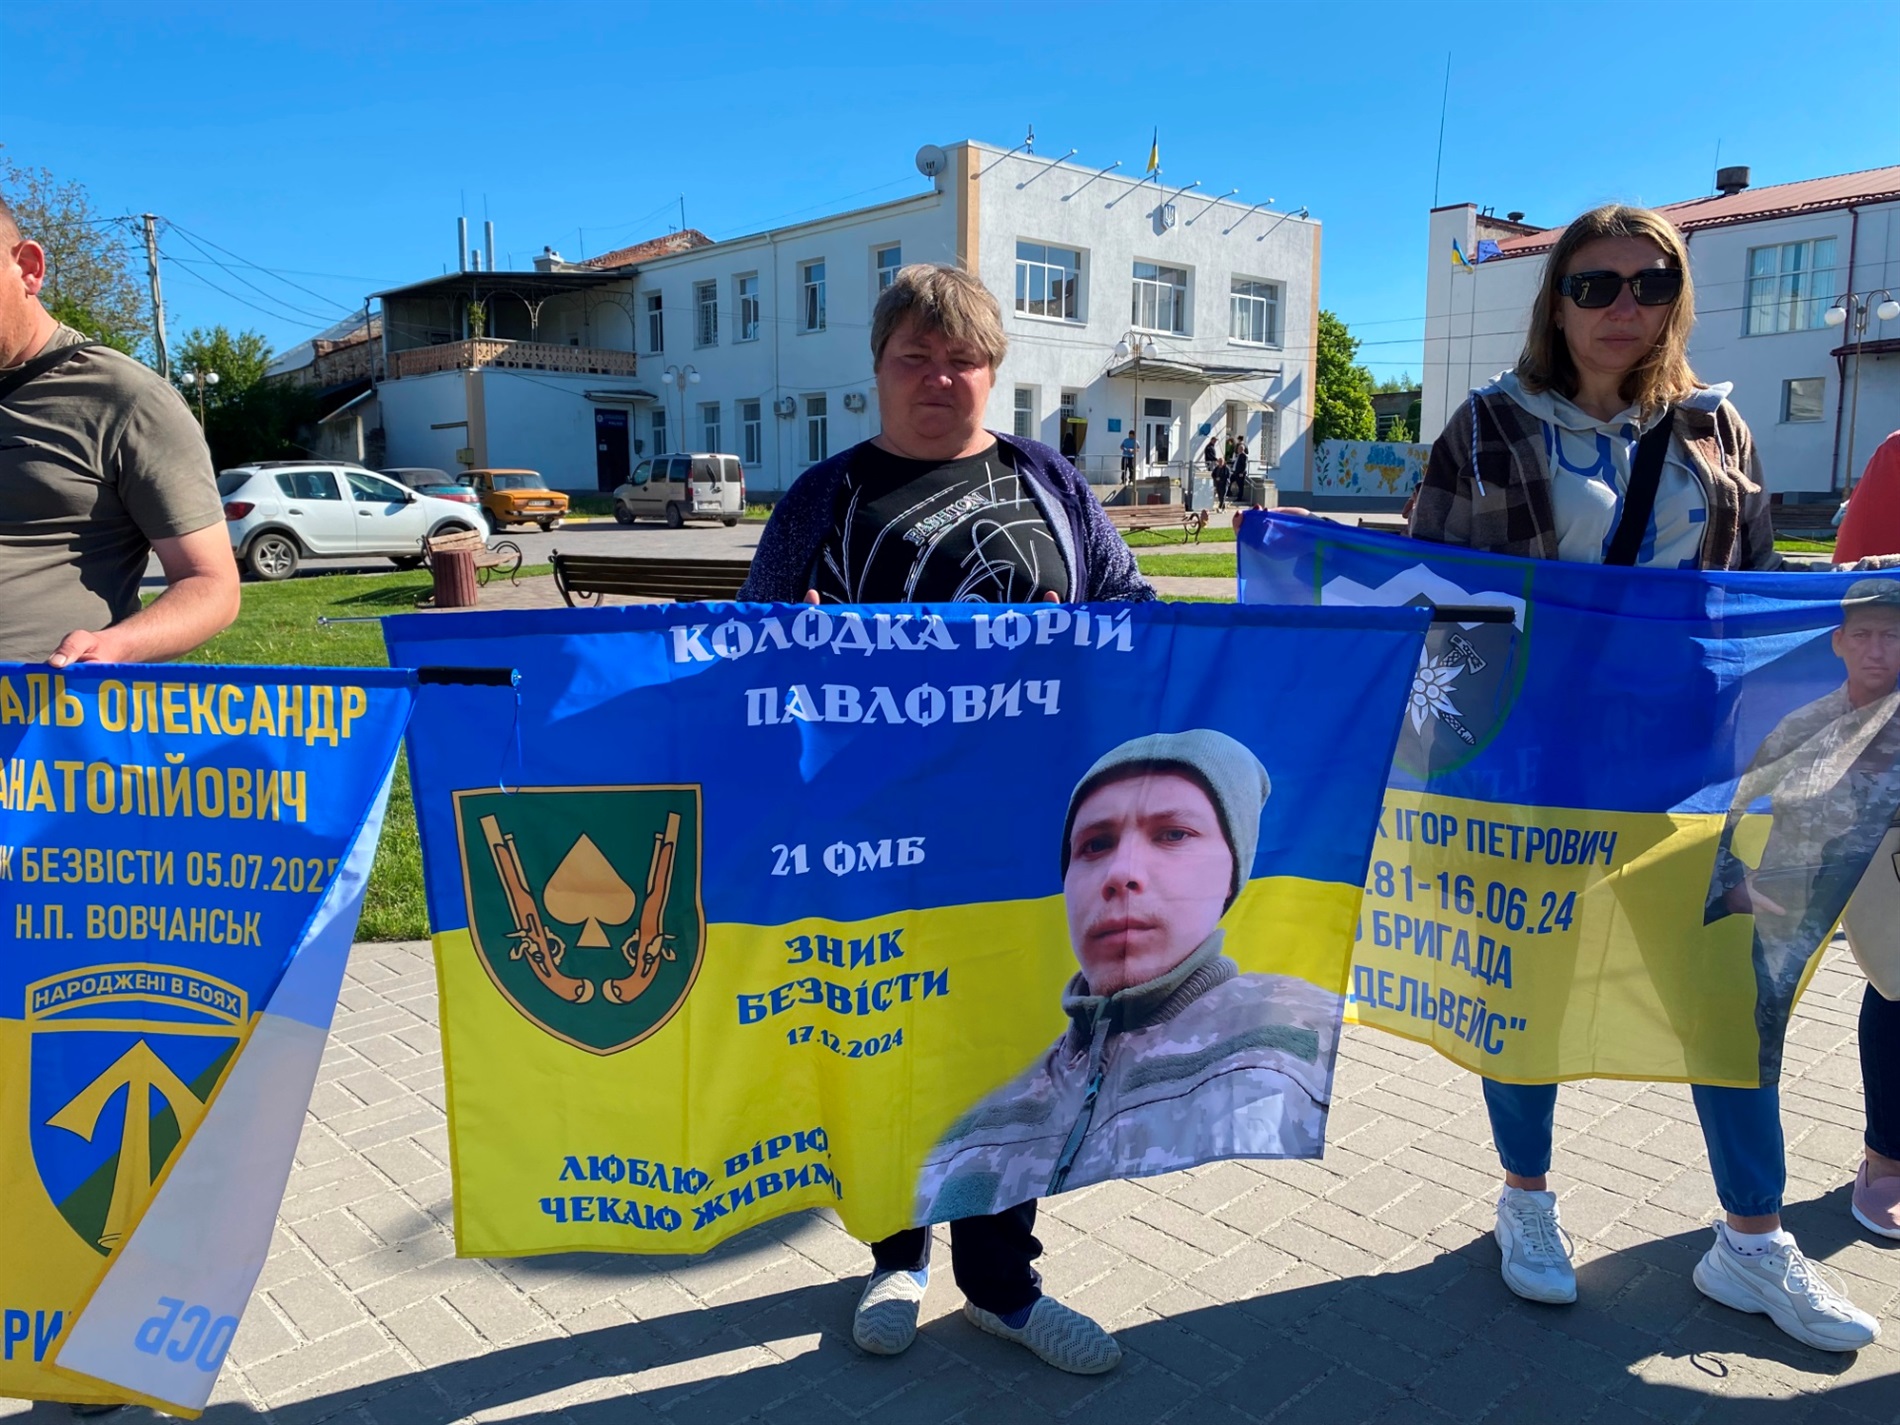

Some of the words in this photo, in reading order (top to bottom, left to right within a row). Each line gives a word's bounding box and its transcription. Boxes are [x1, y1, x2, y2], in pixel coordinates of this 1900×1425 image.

[903, 491, 993, 546] FASHION
[669, 606, 960, 663] КОЛОДКА
[971, 605, 1134, 652] ЮРІЙ
[98, 679, 367, 746] ОЛЕКСАНДР
[744, 679, 1061, 727] ПАВЛОВИЧ
[0, 752, 307, 822] АНАТОЛІЙОВИЧ
[771, 843, 810, 876] 21
[823, 837, 926, 877] ОМБ
[1396, 808, 1458, 847] ІГОР
[1467, 818, 1618, 865] ПЕТРОВИЧ
[22, 847, 174, 885] БЕЗВІСТИ
[16, 904, 73, 940] Н.П.
[86, 905, 262, 947] ВОВЧАНСЬК
[785, 928, 905, 971] ЗНИК
[1372, 910, 1513, 989] БРИГАДА
[35, 973, 165, 1009] НАРОДЖЕНІ
[171, 977, 183, 994] В
[188, 982, 238, 1014] БОЯХ
[737, 967, 949, 1025] БЕЗВІСТИ
[786, 1025, 904, 1059] 17.12.2024
[559, 1154, 715, 1196] ЛЮБЛЮ,
[538, 1196, 682, 1233] ЧЕКАЮ
